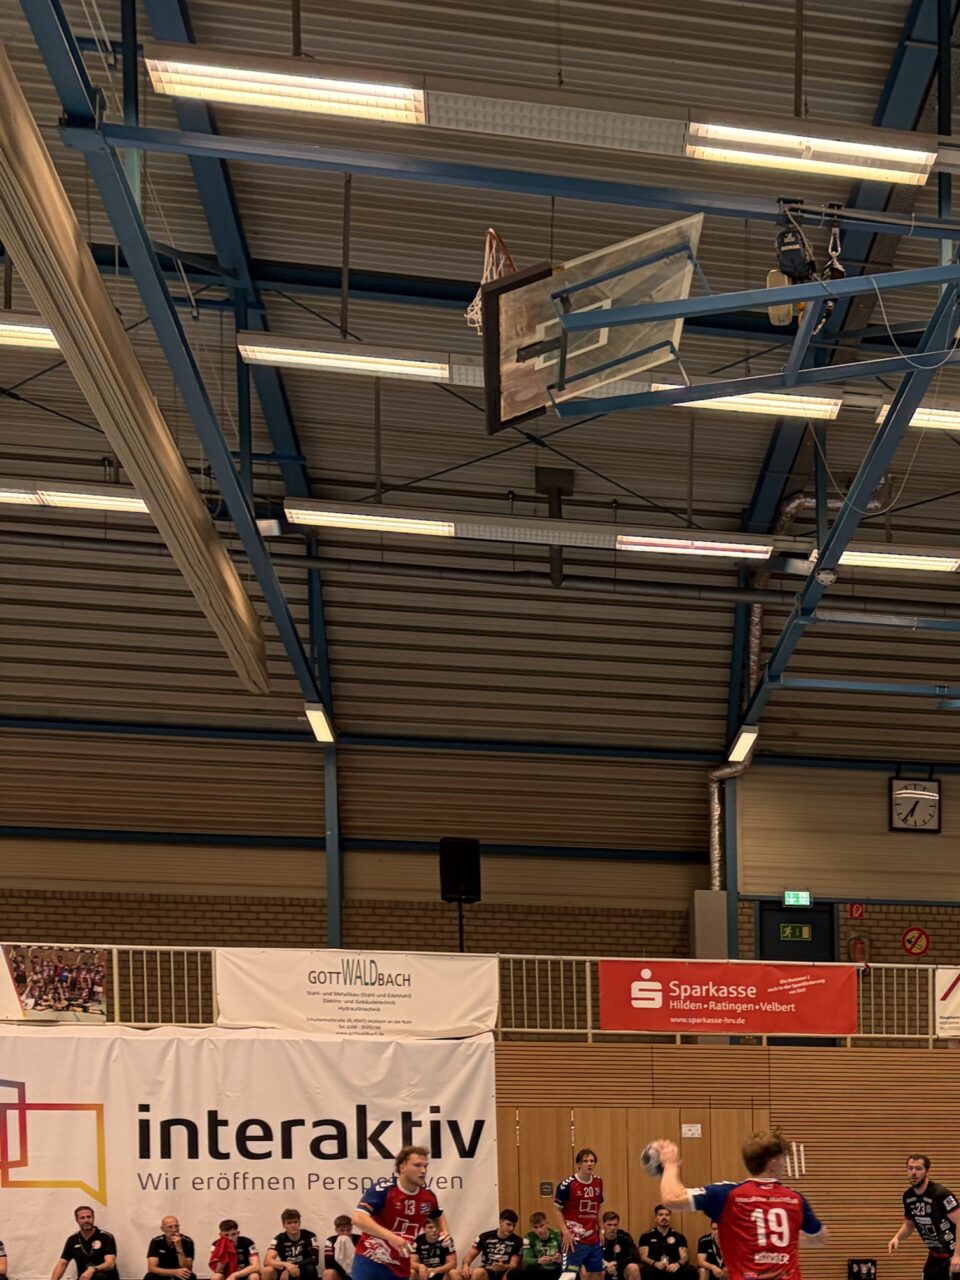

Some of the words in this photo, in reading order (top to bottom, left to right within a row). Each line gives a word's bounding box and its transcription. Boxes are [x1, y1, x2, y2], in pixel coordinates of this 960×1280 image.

[308, 959, 411, 987] GOTTWALDBACH
[669, 981, 757, 999] Sparkasse
[138, 1103, 485, 1160] interaktiv
[138, 1172, 181, 1191] Wir
[192, 1171, 296, 1191] eröffnen
[307, 1171, 464, 1194] Perspeven
[583, 1186, 594, 1198] 20
[404, 1199, 416, 1215] 13
[915, 1202, 926, 1216] 23
[751, 1207, 790, 1247] 19
